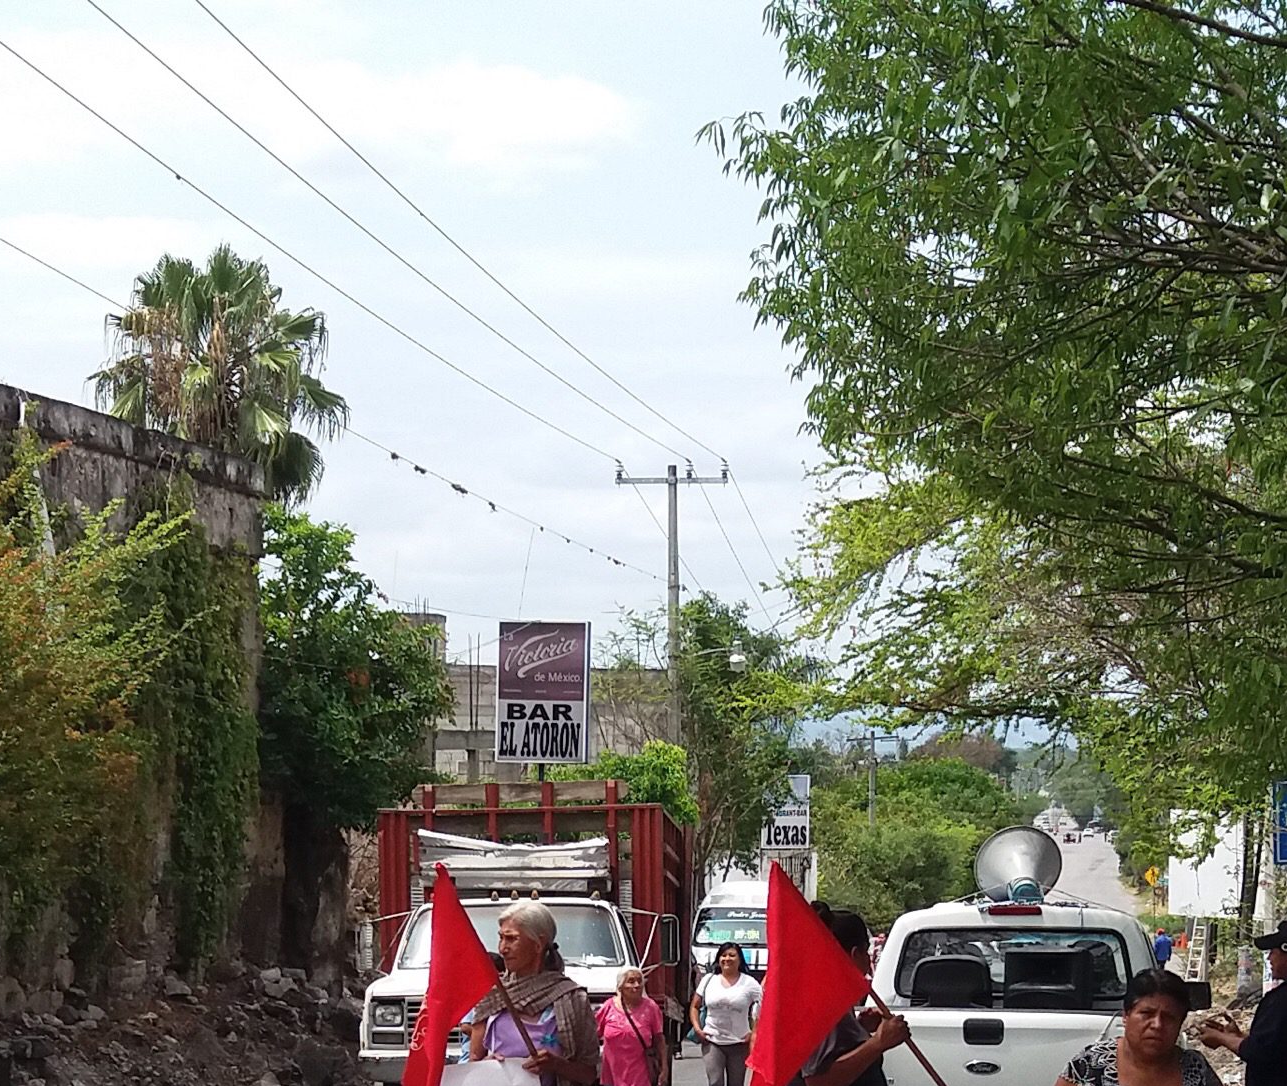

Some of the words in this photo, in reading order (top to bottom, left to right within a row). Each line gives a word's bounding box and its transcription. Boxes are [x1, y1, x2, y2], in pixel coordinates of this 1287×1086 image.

[504, 629, 580, 679] Victoria
[534, 671, 545, 683] de
[506, 703, 573, 721] BAR
[499, 721, 517, 756] EL
[521, 721, 581, 758] ATORON
[765, 823, 807, 846] Texas
